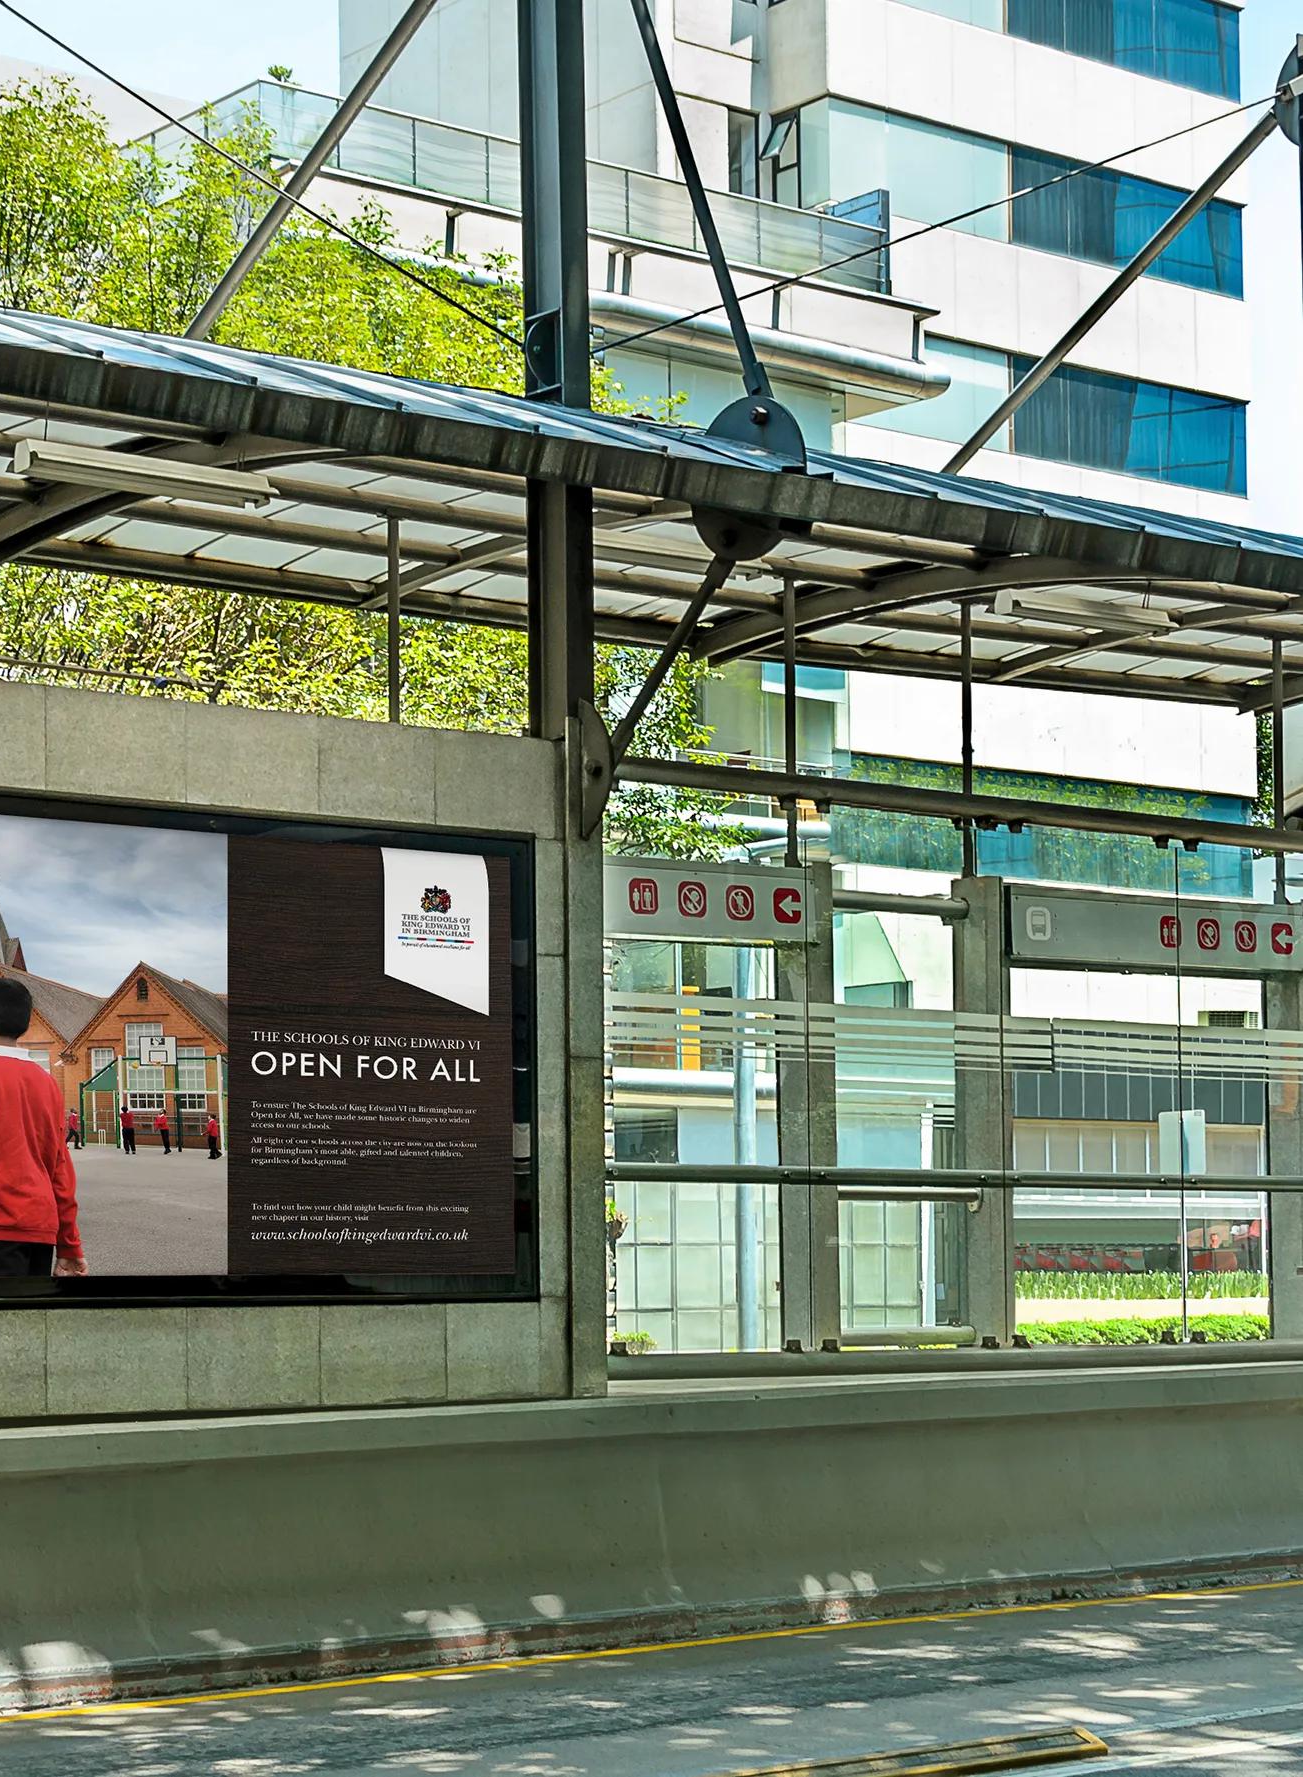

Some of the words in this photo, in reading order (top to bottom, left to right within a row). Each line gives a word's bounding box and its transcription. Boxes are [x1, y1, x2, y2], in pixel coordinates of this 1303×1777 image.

[401, 913, 419, 921] THE
[420, 914, 458, 923] SCHOOLS
[425, 922, 460, 930] EDWARD
[413, 929, 470, 938] BIRMINGHAM
[251, 1031, 281, 1043] THE
[283, 1032, 349, 1045] SCHOOLS
[352, 1035, 371, 1046] OF
[374, 1036, 407, 1048] KING
[410, 1037, 465, 1050] EDWARD
[467, 1040, 481, 1051] VI
[251, 1051, 341, 1078] OPEN
[357, 1055, 418, 1080] FOR
[430, 1058, 481, 1083] ALL
[251, 1101, 261, 1109] To
[290, 1101, 307, 1110] The
[308, 1103, 338, 1111] Schools
[339, 1103, 347, 1111] of
[349, 1104, 367, 1113] King
[369, 1104, 397, 1112] Edward
[408, 1105, 416, 1113] in
[418, 1106, 464, 1115] Birmingham
[251, 1111, 273, 1120] Open
[275, 1111, 287, 1119] for
[288, 1112, 302, 1120] All,
[408, 1116, 438, 1124] changes
[251, 1146, 262, 1154] for
[264, 1146, 318, 1156] Birmingham's
[359, 1149, 381, 1157] gifted
[430, 1149, 464, 1158] children,
[251, 1157, 290, 1166] regardless
[291, 1157, 301, 1165] of
[301, 1157, 348, 1166] background.
[251, 1203, 262, 1211] To
[263, 1203, 280, 1211] find
[297, 1203, 312, 1211] how
[314, 1204, 331, 1213] your
[333, 1203, 353, 1211] child
[354, 1204, 376, 1213] might
[378, 1204, 404, 1212] benefit
[406, 1204, 424, 1212] from
[426, 1204, 439, 1212] this
[440, 1205, 469, 1214] exciting
[268, 1214, 298, 1222] chapter
[325, 1214, 353, 1223] history,
[250, 1228, 469, 1245] www.schoolsofkingedwardvi.co.uk
